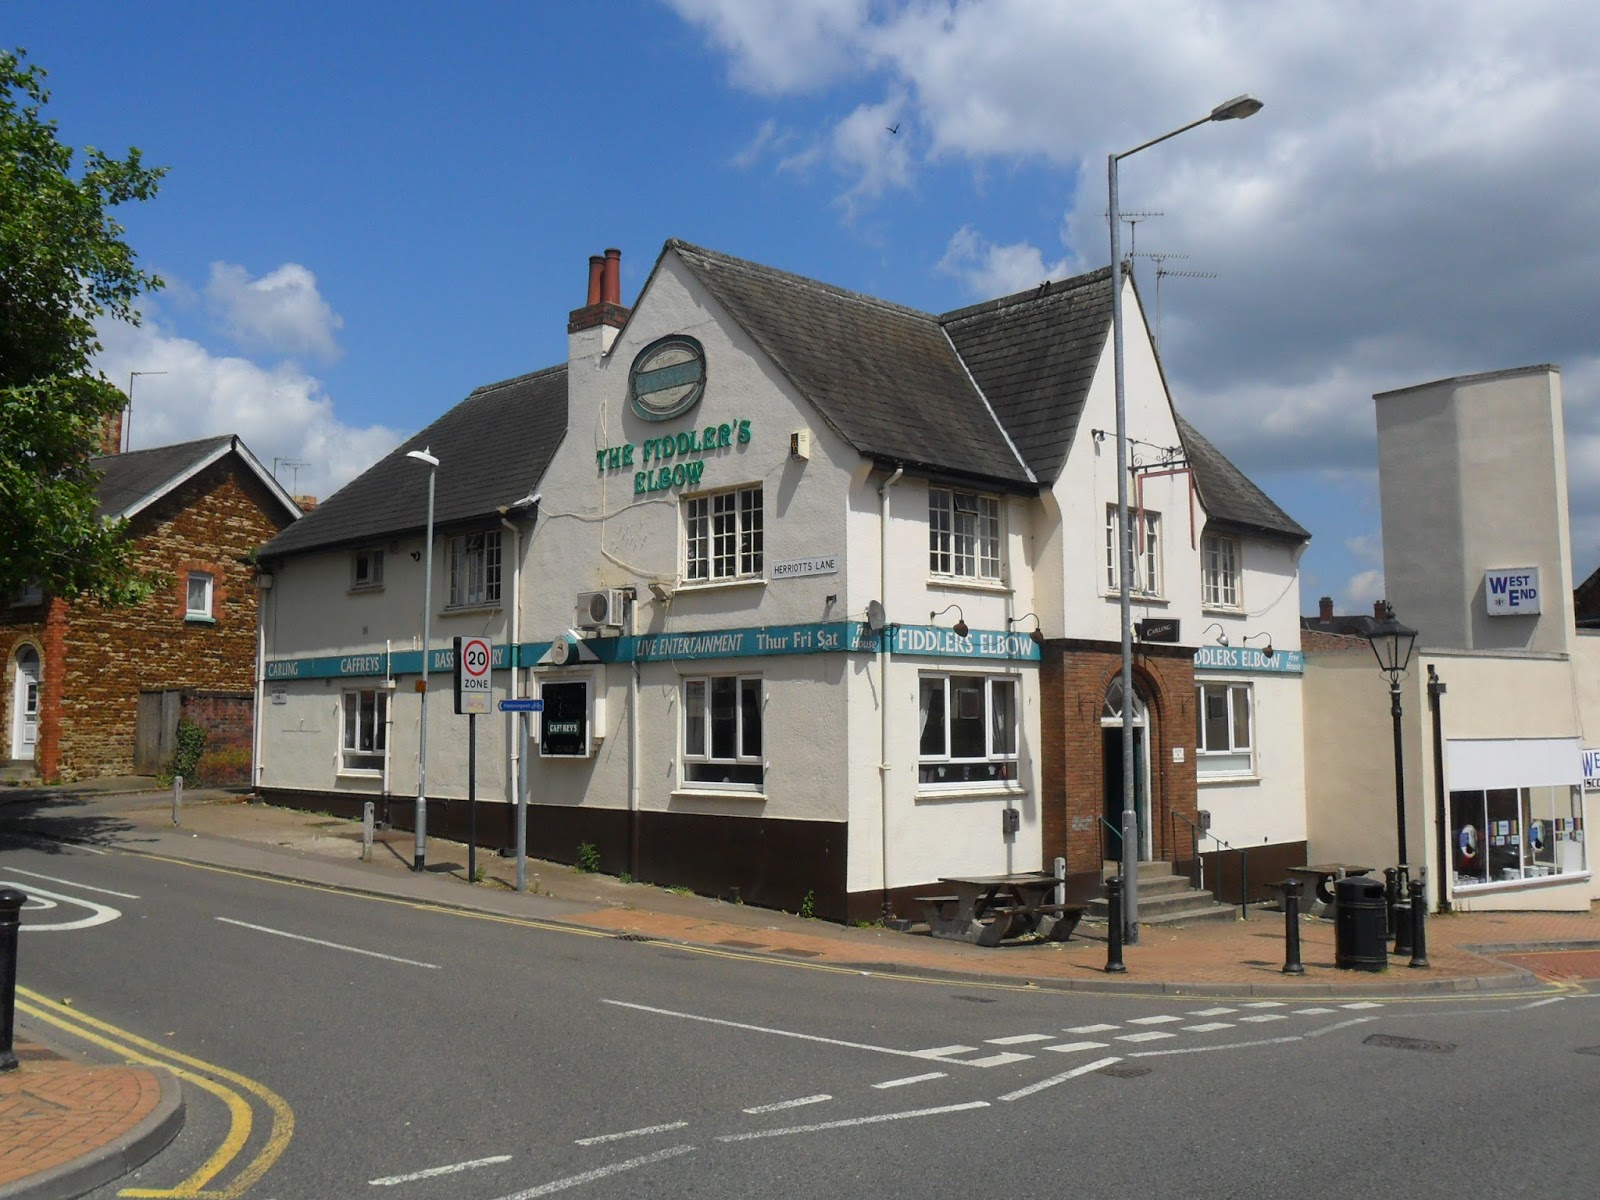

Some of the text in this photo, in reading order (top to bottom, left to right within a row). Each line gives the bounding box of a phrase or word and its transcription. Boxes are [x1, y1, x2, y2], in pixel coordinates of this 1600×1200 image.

[597, 418, 752, 471] THE FIDDLER'S
[634, 460, 705, 494] ELBOW
[774, 559, 835, 575] HERRIOTTS LANE
[1488, 575, 1530, 594] WEST
[1509, 588, 1537, 606] END
[636, 629, 839, 657] LIVE ENTERTAINMENT Thur Fri Sat
[851, 637, 877, 649] House
[898, 629, 1033, 656] FIDDLERS ELBOW
[268, 662, 298, 677] CARLING
[340, 656, 380, 673] CAFFREYS
[434, 651, 455, 668] BASS
[468, 651, 486, 666] 20
[1241, 650, 1280, 669] ELBOW
[464, 679, 488, 689] ZONE
